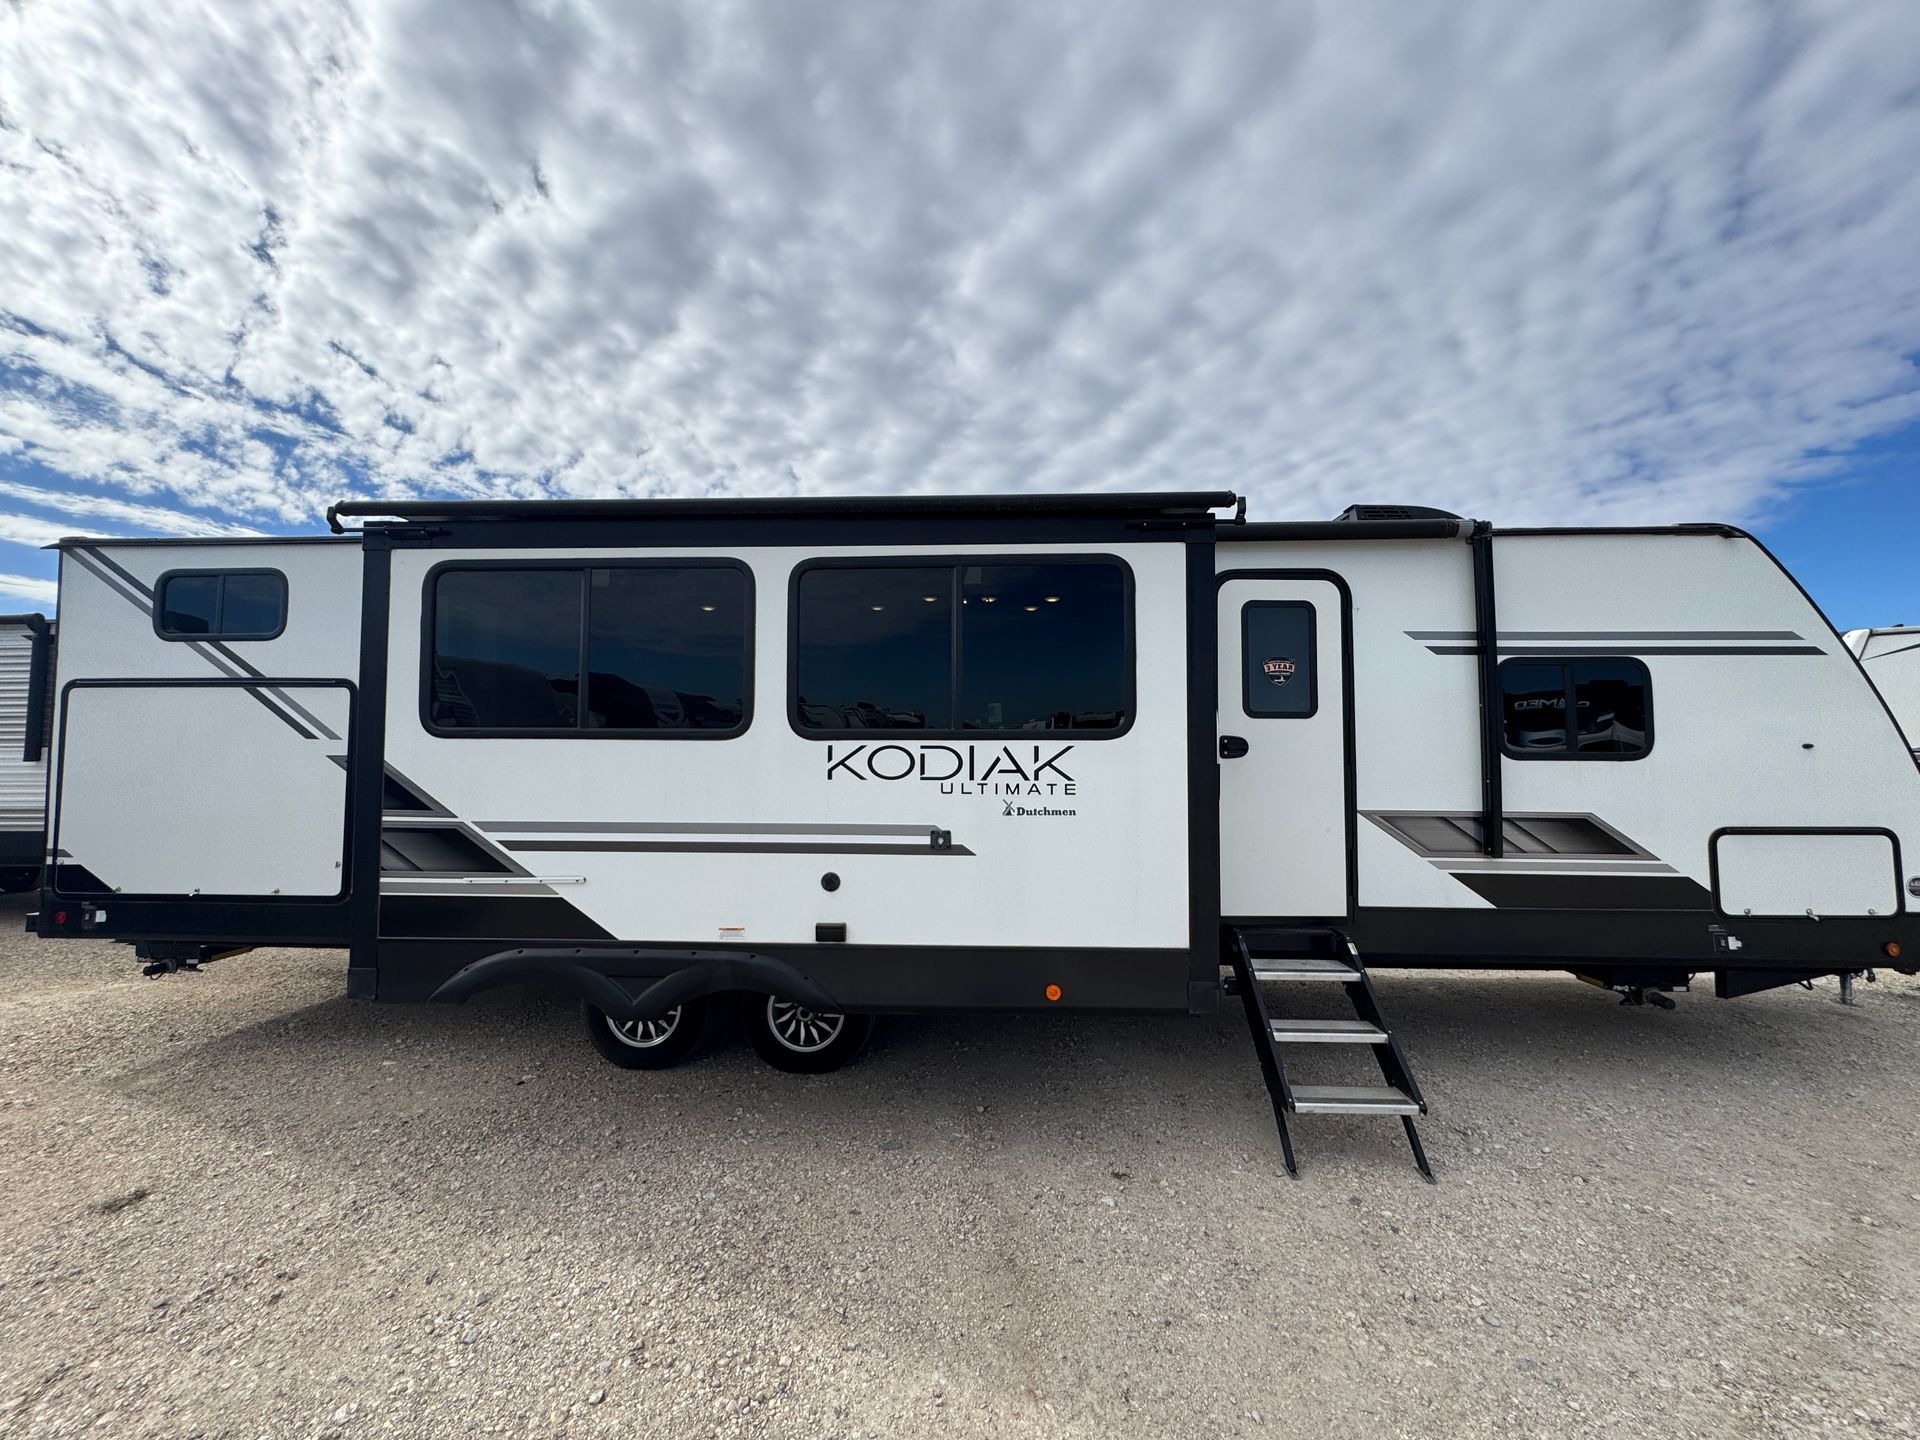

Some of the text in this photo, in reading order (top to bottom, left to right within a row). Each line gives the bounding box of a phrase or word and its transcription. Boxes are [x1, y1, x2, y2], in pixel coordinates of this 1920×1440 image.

[1272, 663, 1293, 671] YEAR
[827, 744, 1075, 781] KODIAK
[940, 782, 1077, 795] ULTIMATE
[1016, 806, 1077, 816] Dutchmen
